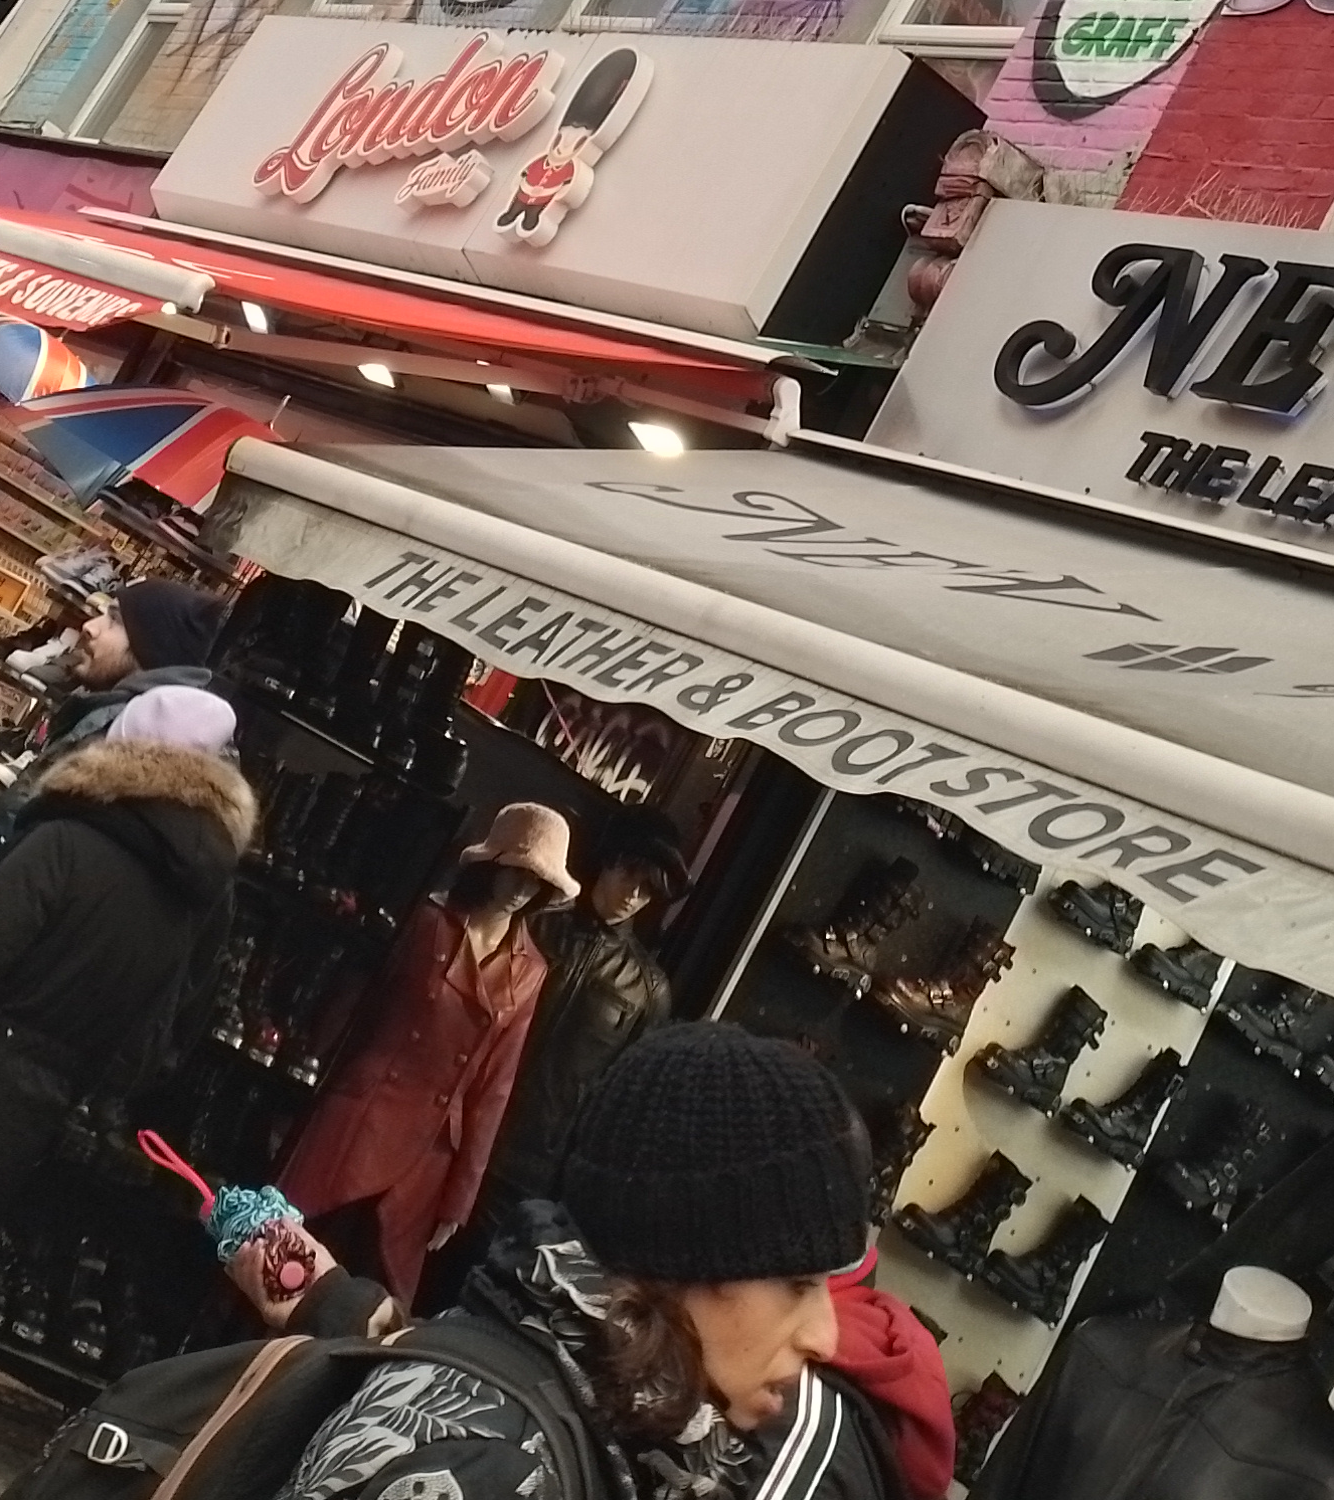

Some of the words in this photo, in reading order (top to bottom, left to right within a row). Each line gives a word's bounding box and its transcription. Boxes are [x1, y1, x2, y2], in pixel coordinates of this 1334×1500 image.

[1061, 12, 1196, 60] GRAFF
[252, 31, 550, 192] London
[397, 152, 476, 200] Family
[1123, 431, 1255, 502] THE
[583, 480, 1163, 623] NEW
[364, 551, 481, 613] THE
[449, 584, 707, 695] LEATHER
[676, 672, 754, 716] &
[725, 690, 973, 786] BOOT
[929, 765, 1267, 904] STORE
